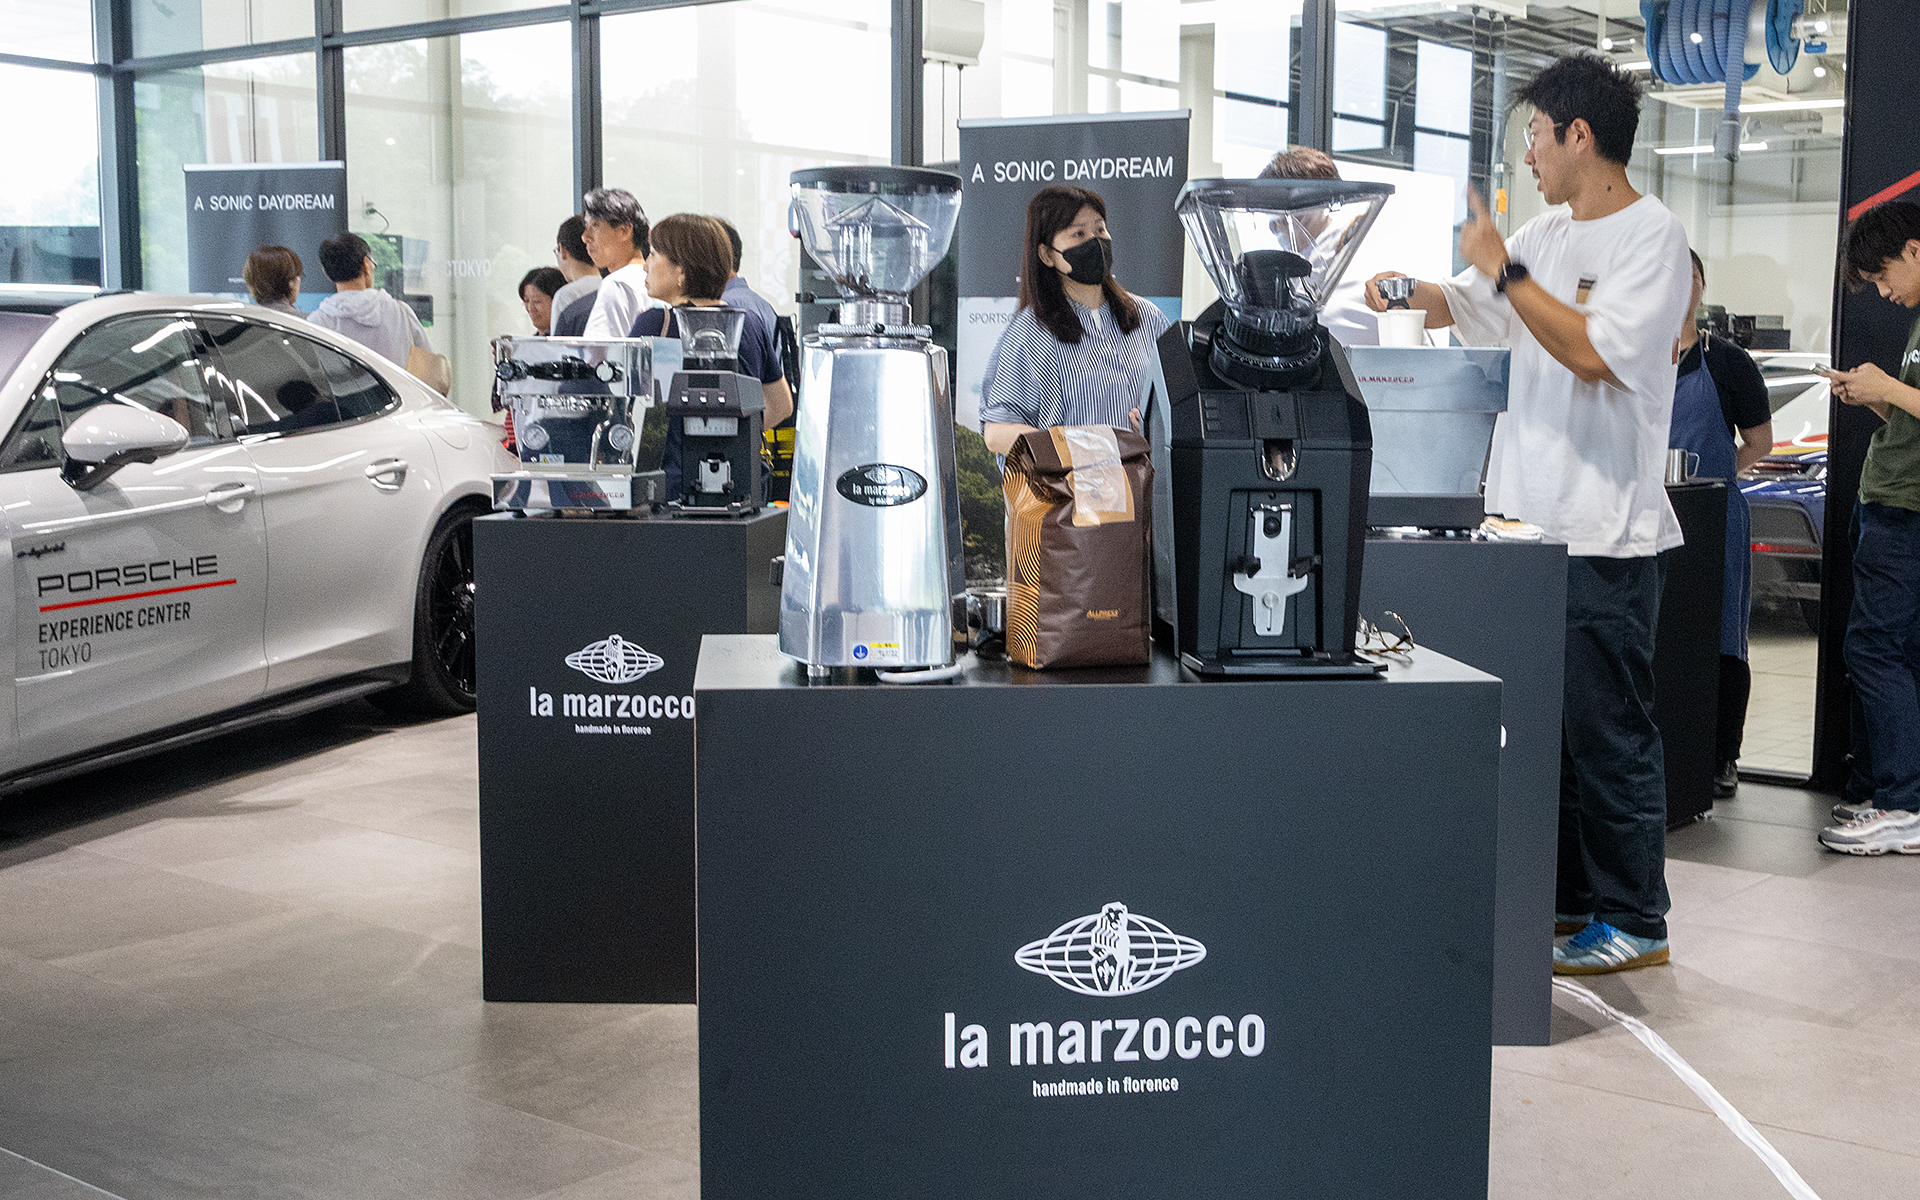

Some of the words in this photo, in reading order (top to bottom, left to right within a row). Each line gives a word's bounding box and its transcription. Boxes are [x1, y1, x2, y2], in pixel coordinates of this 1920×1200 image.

[971, 162, 986, 184] A
[994, 160, 1056, 183] SONIC
[1064, 156, 1174, 181] DAYDREAM
[193, 196, 205, 211] A
[210, 194, 254, 211] SONIC
[258, 193, 335, 210] DAYDREAM
[852, 482, 862, 495] la
[37, 554, 218, 598] PORSCHE
[38, 608, 134, 644] EXPERIENCE
[138, 601, 191, 628] CENTER
[38, 642, 93, 670] TOKYO
[529, 686, 554, 717] la
[563, 694, 696, 720] marzocco
[575, 723, 612, 734] handmade
[613, 724, 621, 735] in
[621, 724, 651, 736] florence
[944, 1011, 989, 1069] la
[1009, 1013, 1266, 1067] marzocco
[1032, 1077, 1104, 1098] handmade
[1106, 1076, 1120, 1095] in
[1122, 1075, 1180, 1094] florence
